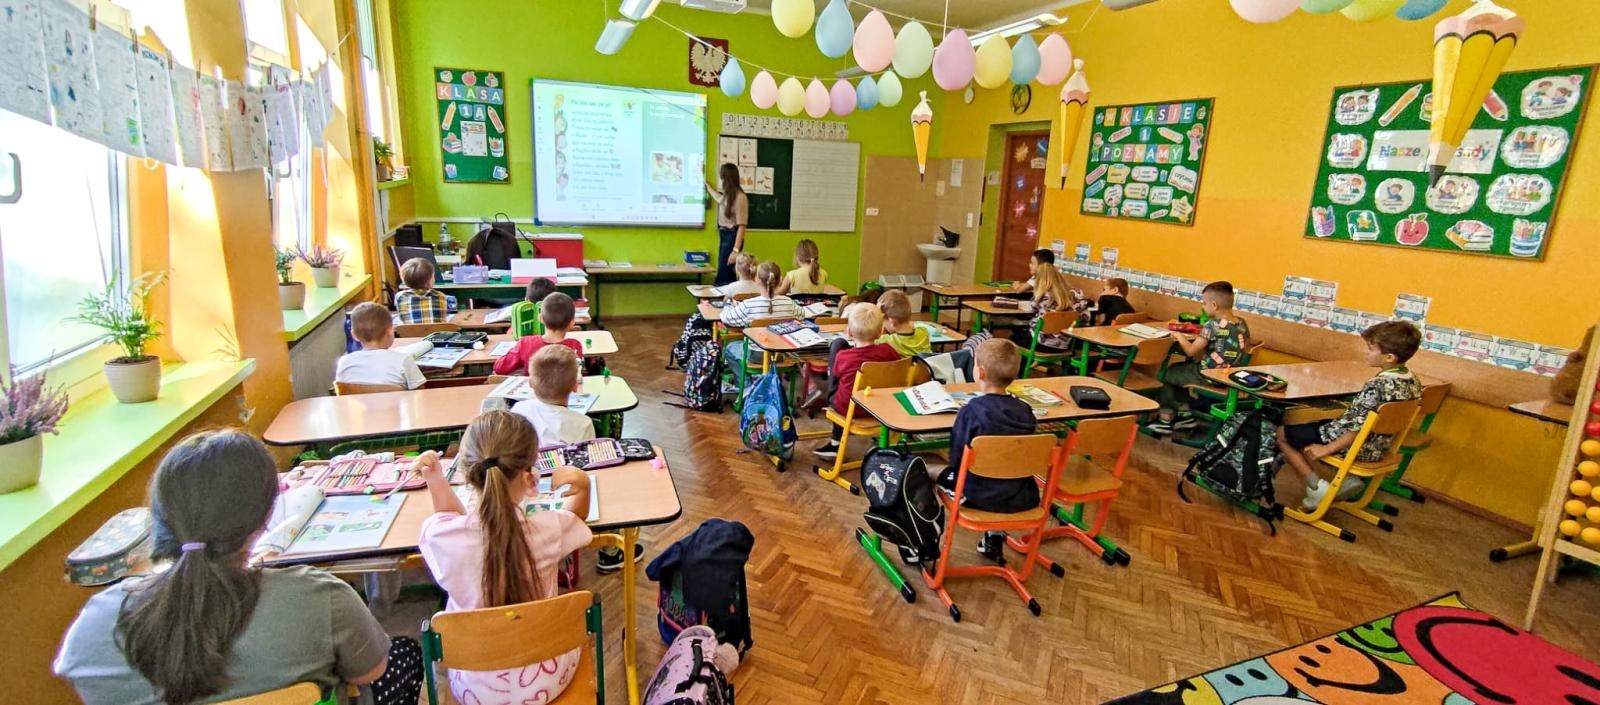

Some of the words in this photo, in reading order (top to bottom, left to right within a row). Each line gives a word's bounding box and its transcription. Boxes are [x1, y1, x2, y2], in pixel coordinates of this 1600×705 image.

[439, 86, 501, 101] KLASA
[462, 105, 485, 119] 1A
[1122, 107, 1192, 121] KLASIE
[1141, 128, 1148, 140] 1
[1103, 146, 1180, 160] POZNAMY
